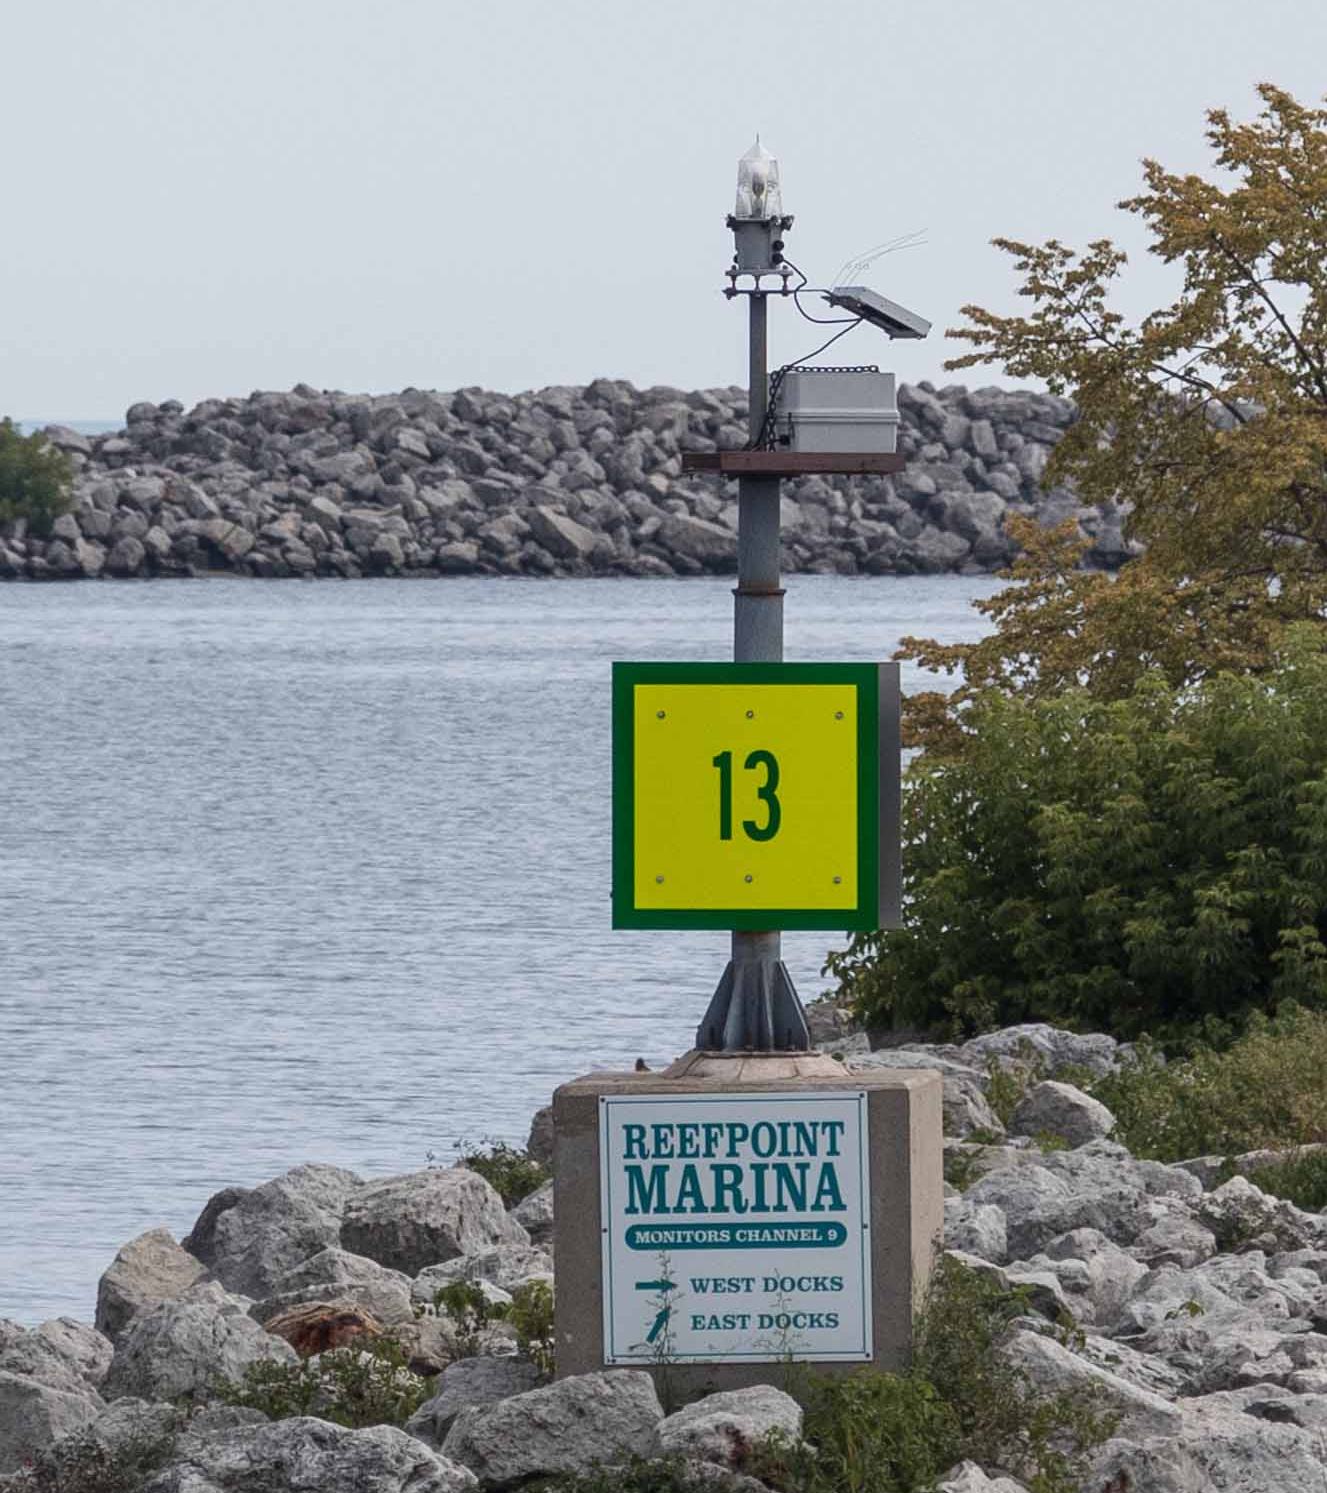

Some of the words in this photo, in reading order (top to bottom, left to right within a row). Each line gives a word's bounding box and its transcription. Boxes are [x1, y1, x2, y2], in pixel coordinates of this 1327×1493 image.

[711, 749, 782, 842] 13
[622, 1121, 845, 1160] REEFPOINT
[624, 1161, 847, 1215] MARINA
[635, 1229, 731, 1244] MONITORS
[735, 1228, 823, 1243] CHANNEL
[827, 1229, 838, 1241] 9
[690, 1277, 755, 1293] WEST
[763, 1276, 844, 1293] DOCKS
[690, 1314, 752, 1331] EAST
[757, 1313, 839, 1330] DOCKS
